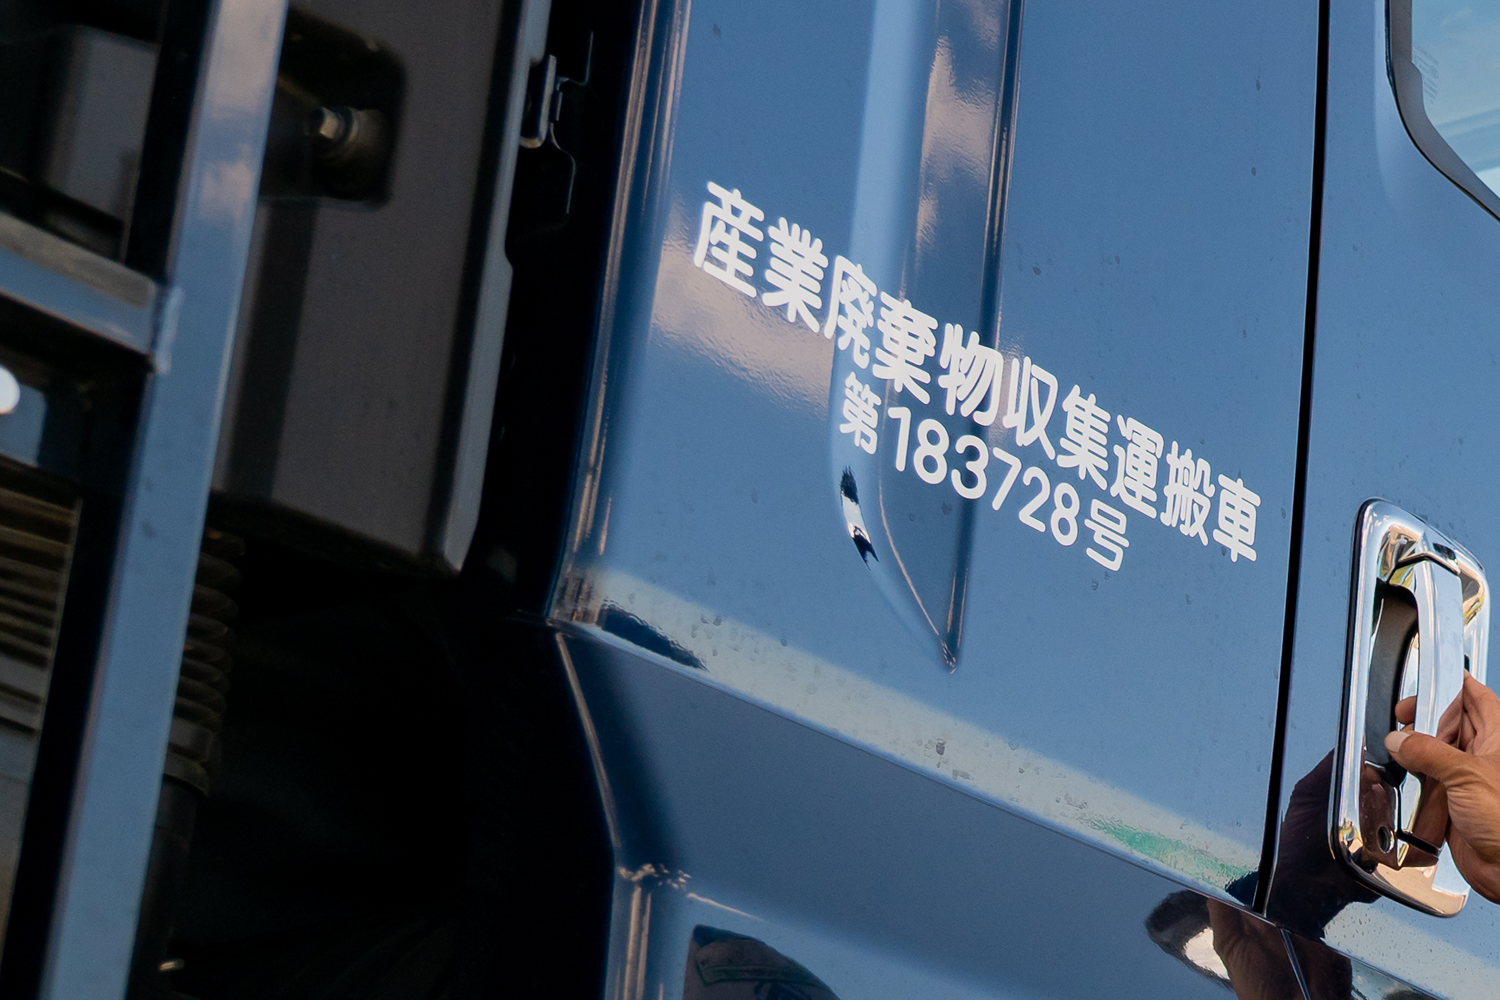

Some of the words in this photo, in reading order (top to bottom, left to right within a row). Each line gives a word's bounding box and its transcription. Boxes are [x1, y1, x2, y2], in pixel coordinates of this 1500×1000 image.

[693, 181, 1261, 563] 産業廃棄物収集運搬車
[838, 371, 1130, 572] 第183728号
